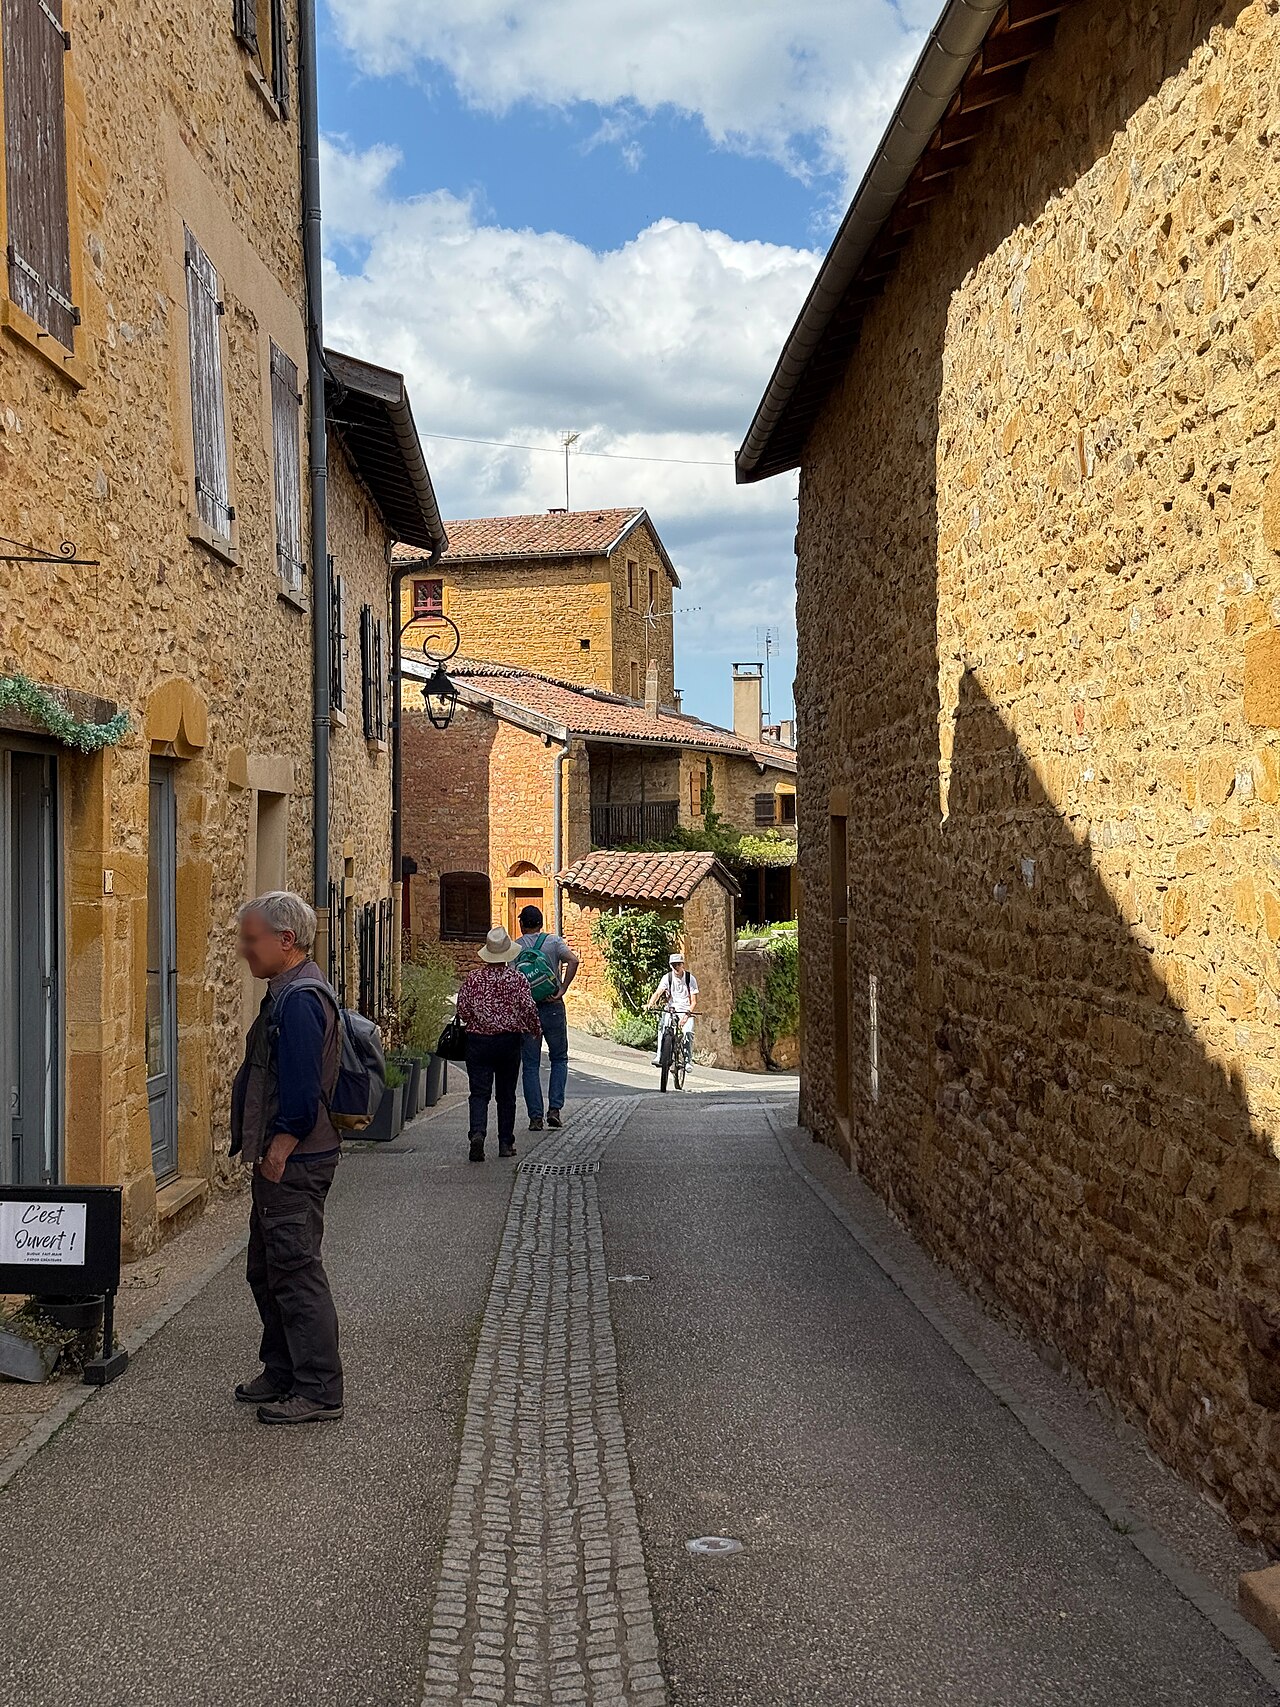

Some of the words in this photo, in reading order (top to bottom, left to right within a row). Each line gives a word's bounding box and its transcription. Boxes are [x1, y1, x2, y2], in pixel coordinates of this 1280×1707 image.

[21, 1204, 66, 1226] C'est
[14, 1228, 67, 1251] Ouvert
[69, 1231, 77, 1251] !
